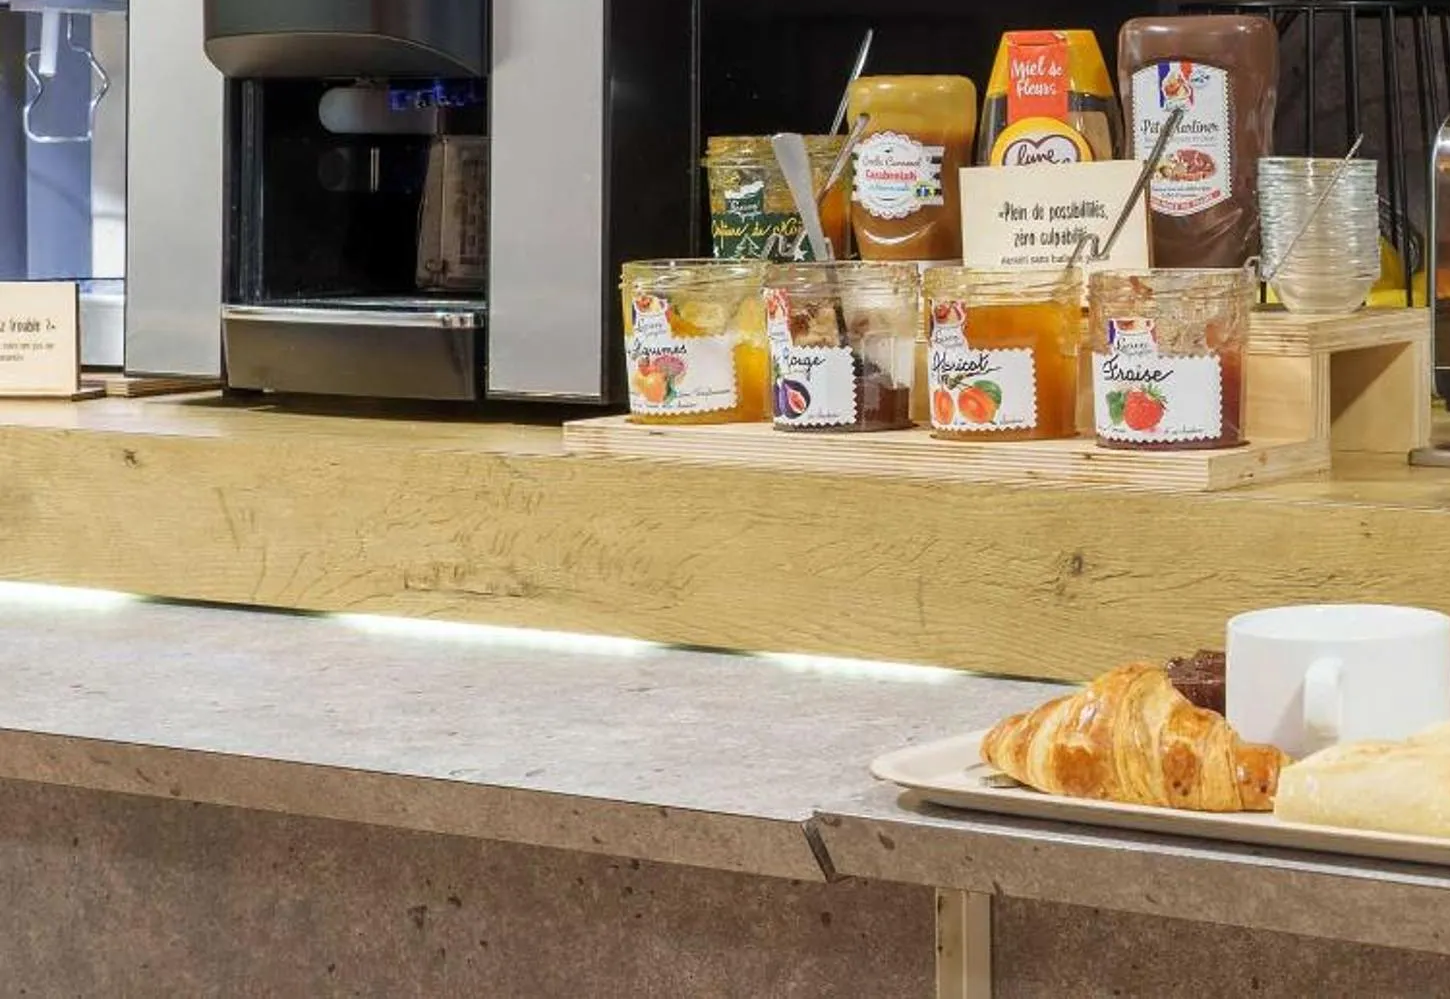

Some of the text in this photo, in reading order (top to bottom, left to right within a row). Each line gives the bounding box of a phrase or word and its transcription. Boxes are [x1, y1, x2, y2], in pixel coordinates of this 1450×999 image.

[1012, 55, 1046, 80] Miel
[1016, 79, 1058, 99] Fleurs
[1031, 202, 1045, 221] de
[1013, 227, 1035, 248] zéro
[1102, 353, 1174, 383] Fraise
